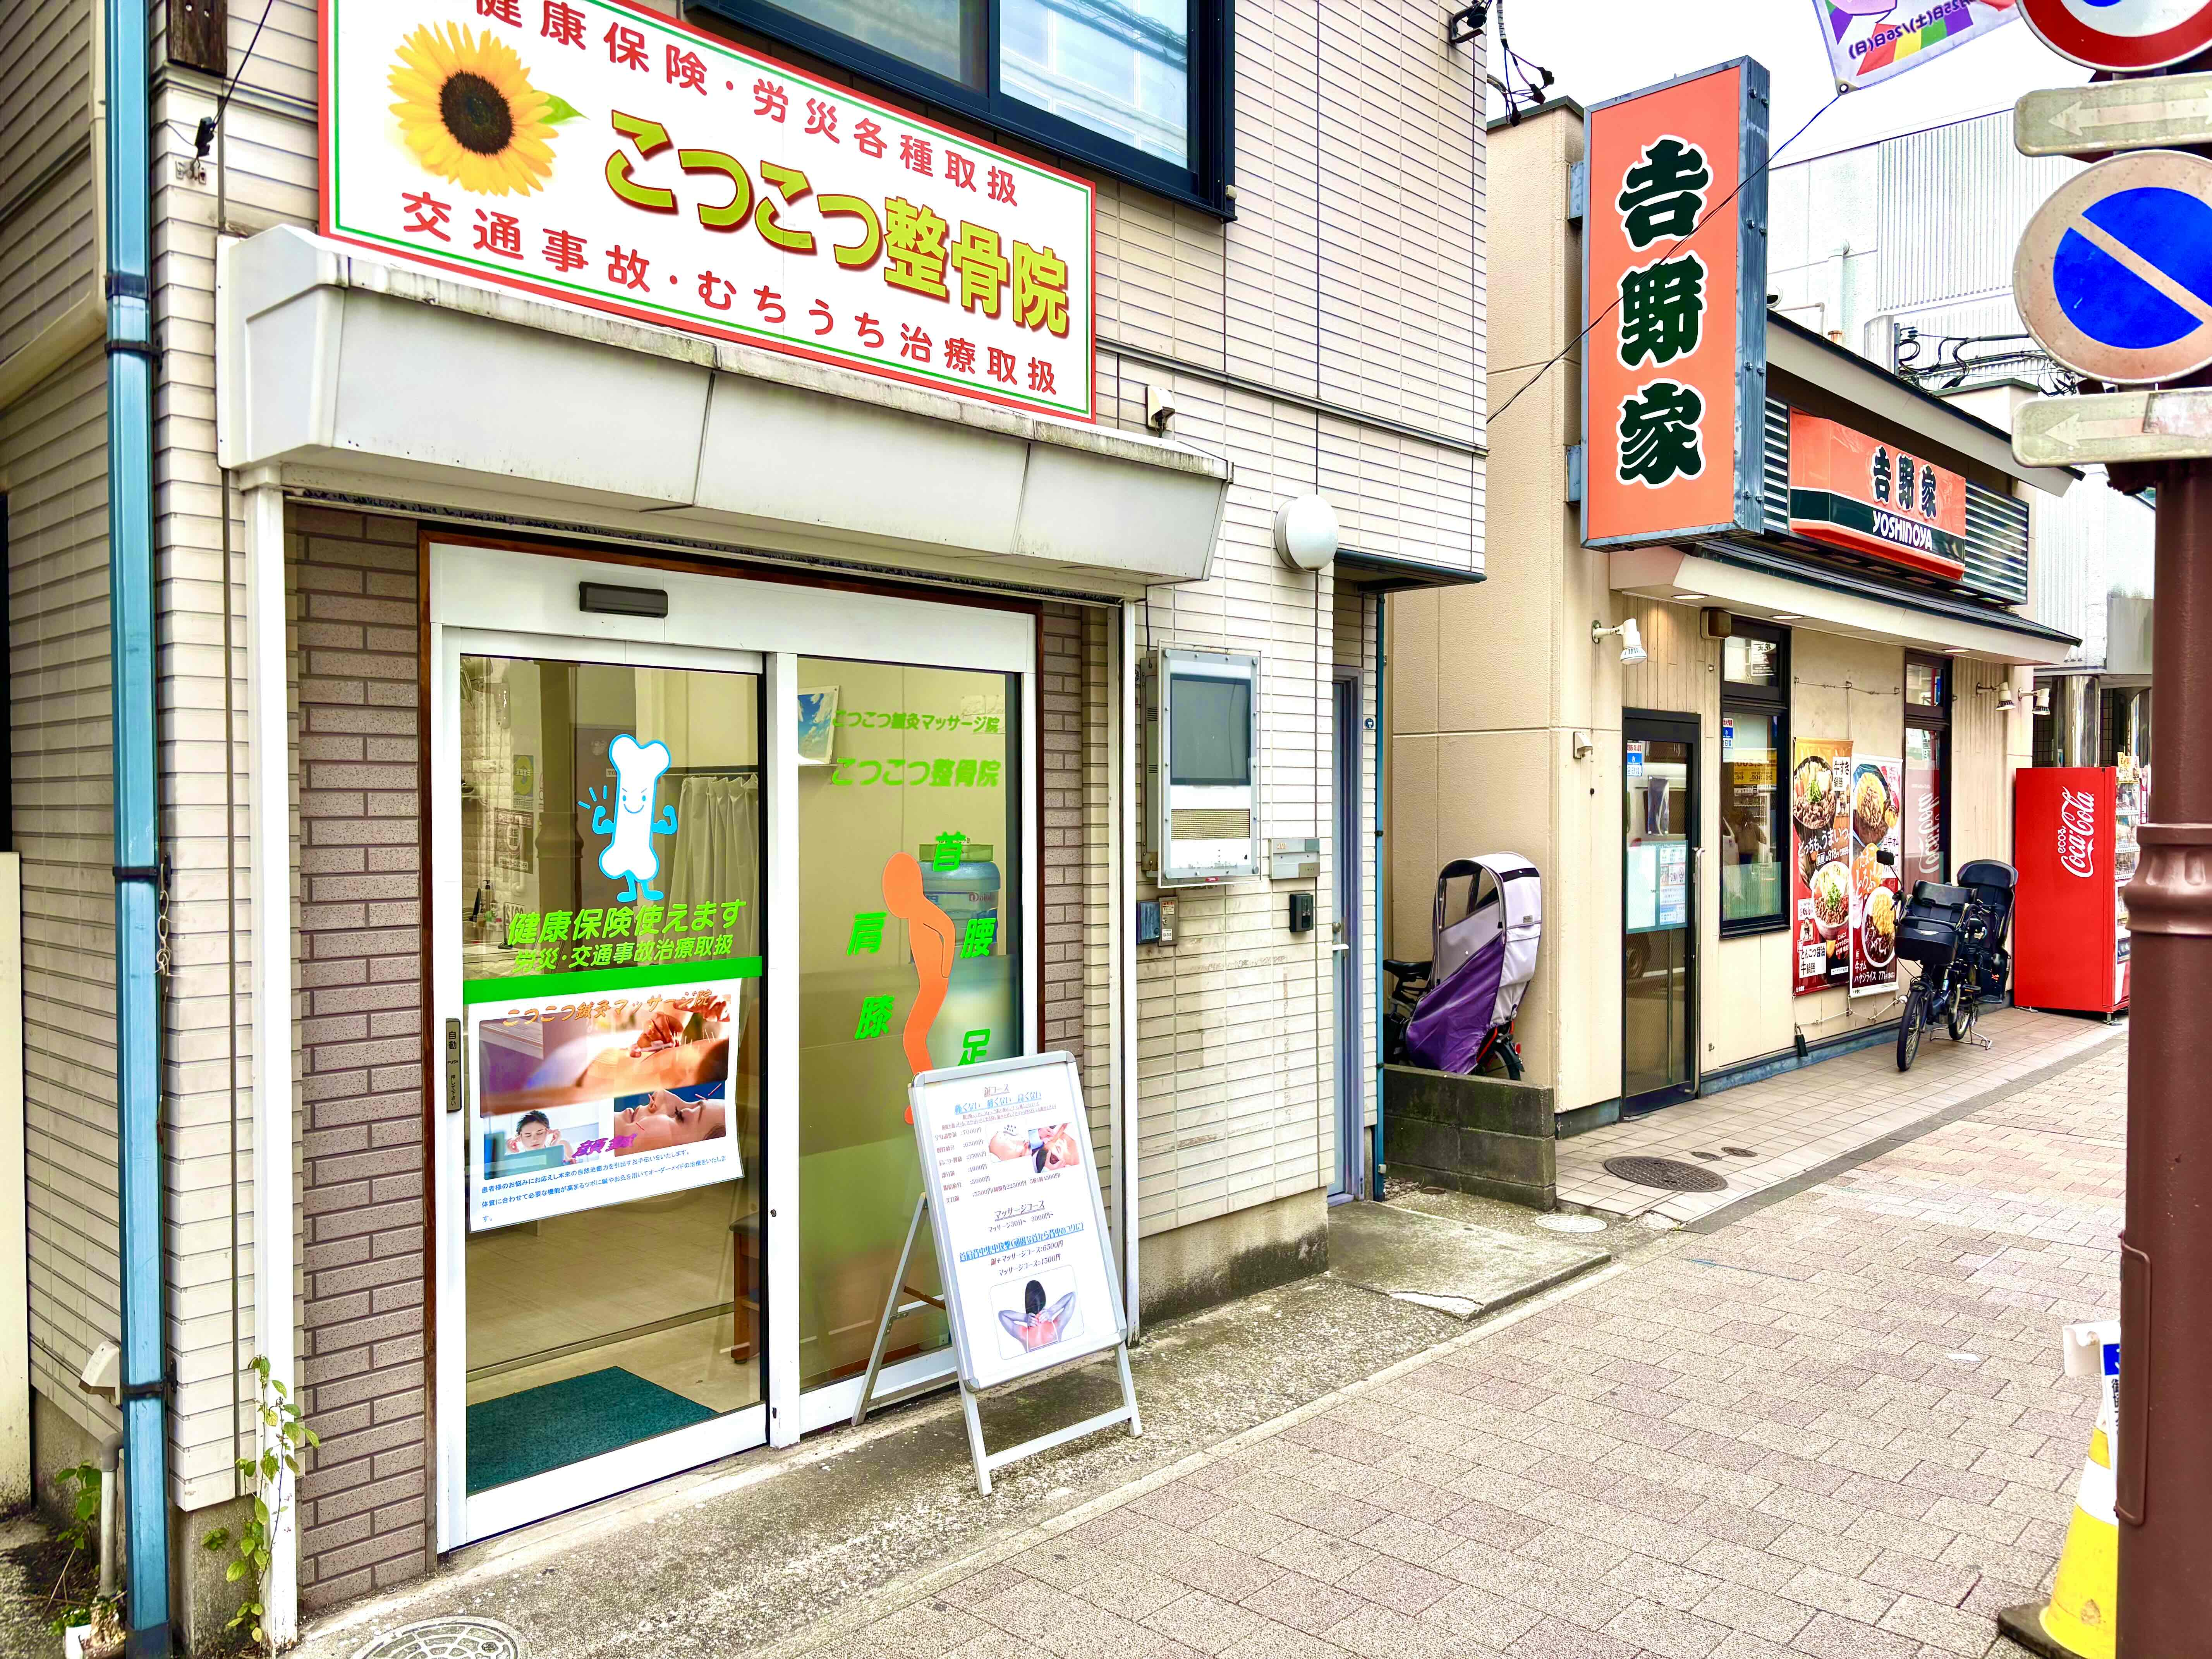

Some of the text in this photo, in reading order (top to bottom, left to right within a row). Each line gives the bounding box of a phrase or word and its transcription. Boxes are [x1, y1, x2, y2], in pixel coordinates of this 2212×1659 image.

[476, 0, 1017, 206] 健康保険・労災各種取扱
[605, 109, 1068, 336] こつこつ整骨院
[402, 191, 1057, 395] 交通事故・むちうち治療取扱
[1616, 134, 1713, 489] 吉野家
[1870, 445, 1937, 520] 吉野家
[1872, 510, 1933, 551] YOSHINOYA
[831, 757, 1001, 787] こつこつ整骨院
[1834, 760, 1850, 775] 牛すき
[933, 831, 966, 871] 首
[2061, 786, 2094, 878] Coca-Cola
[507, 899, 747, 946] 健康保険使えます
[847, 912, 997, 958] 肩 腰
[512, 934, 733, 974] 労災・交通事故治療取扱
[448, 1030, 457, 1049] 自動
[855, 994, 991, 1066] 膝 足
